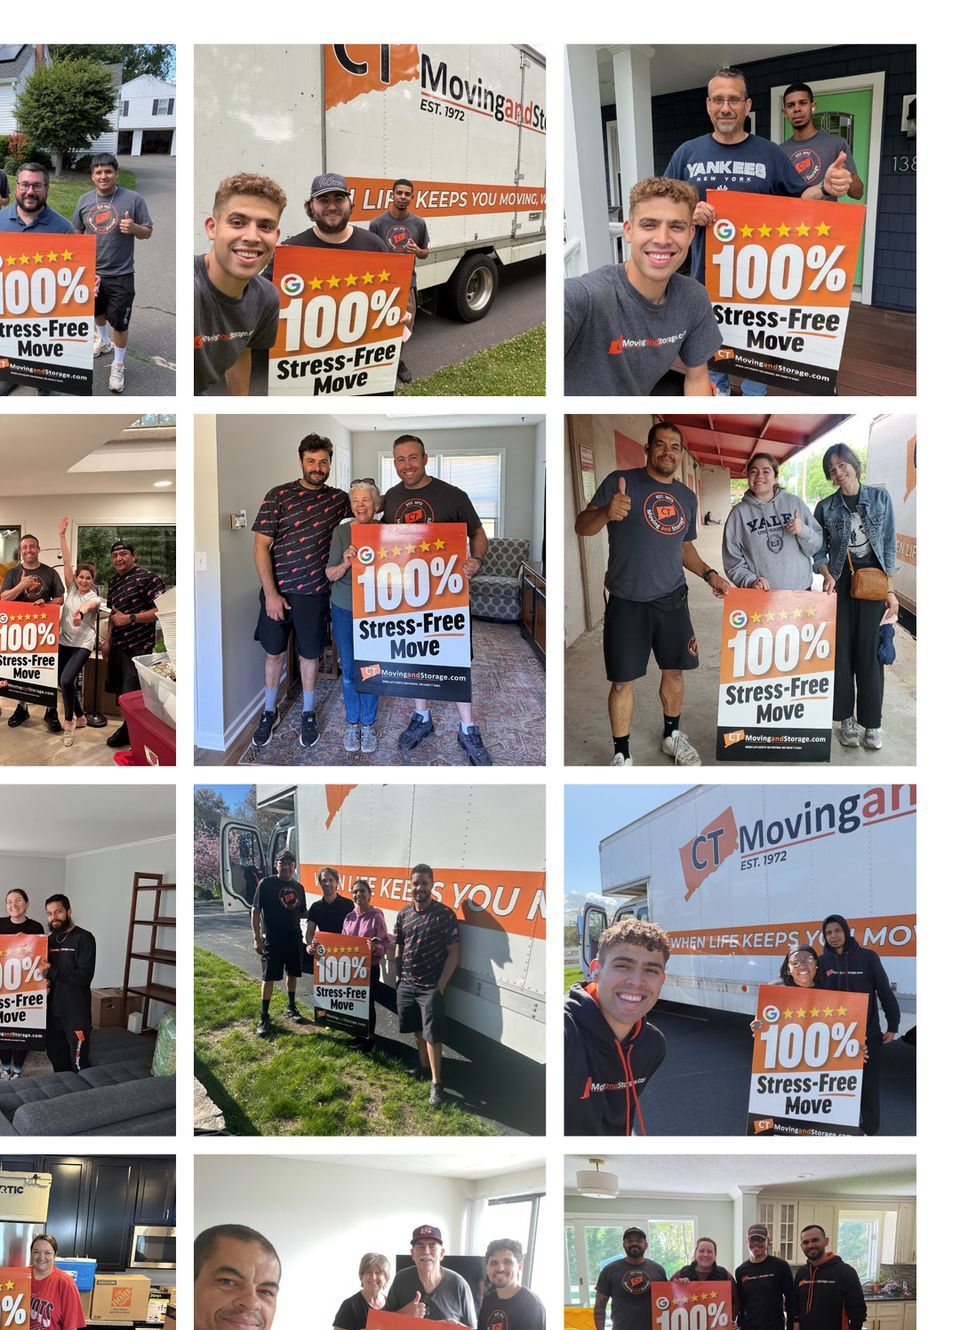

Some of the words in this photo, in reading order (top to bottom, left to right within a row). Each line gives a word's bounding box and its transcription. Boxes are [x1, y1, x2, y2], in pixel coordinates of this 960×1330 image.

[420, 99, 441, 115] EST.
[444, 106, 465, 121] 1972
[686, 160, 767, 178] YANKEES
[362, 188, 395, 210] LIF
[415, 191, 467, 209] KEEPS
[471, 191, 497, 207] YOU
[499, 192, 539, 207] MOVING,
[712, 244, 847, 301] 100%
[279, 287, 400, 352] 100%
[714, 305, 840, 332] Stress-Free
[18, 340, 63, 358] Move
[747, 329, 804, 352] Move
[277, 344, 395, 380] Stress-Free
[718, 350, 731, 359] CT
[734, 354, 830, 382] MovingandStorage.com
[313, 371, 368, 396] Move
[358, 555, 463, 613] 100%
[359, 613, 465, 640] Stress-Free
[390, 639, 440, 659] Move
[728, 622, 830, 678] 100%
[381, 669, 466, 682] MovingandStorage.com
[726, 676, 829, 706] Stress-Free
[756, 702, 804, 724] Move
[727, 733, 741, 742] CT
[745, 734, 826, 744] MovingandStorage.com
[692, 828, 724, 869] CT
[740, 858, 760, 871] EST.
[763, 851, 786, 866] 1972
[379, 878, 444, 902] KEES
[446, 883, 520, 916] YOU
[670, 936, 705, 950] WHEN
[709, 935, 738, 949] LIFE
[743, 931, 799, 948] KEEPS
[316, 956, 367, 984] 100%
[316, 986, 367, 999] Stress-Free
[761, 1021, 858, 1070] 100%
[757, 1073, 857, 1095] Stress-Free
[785, 1097, 832, 1115] Move
